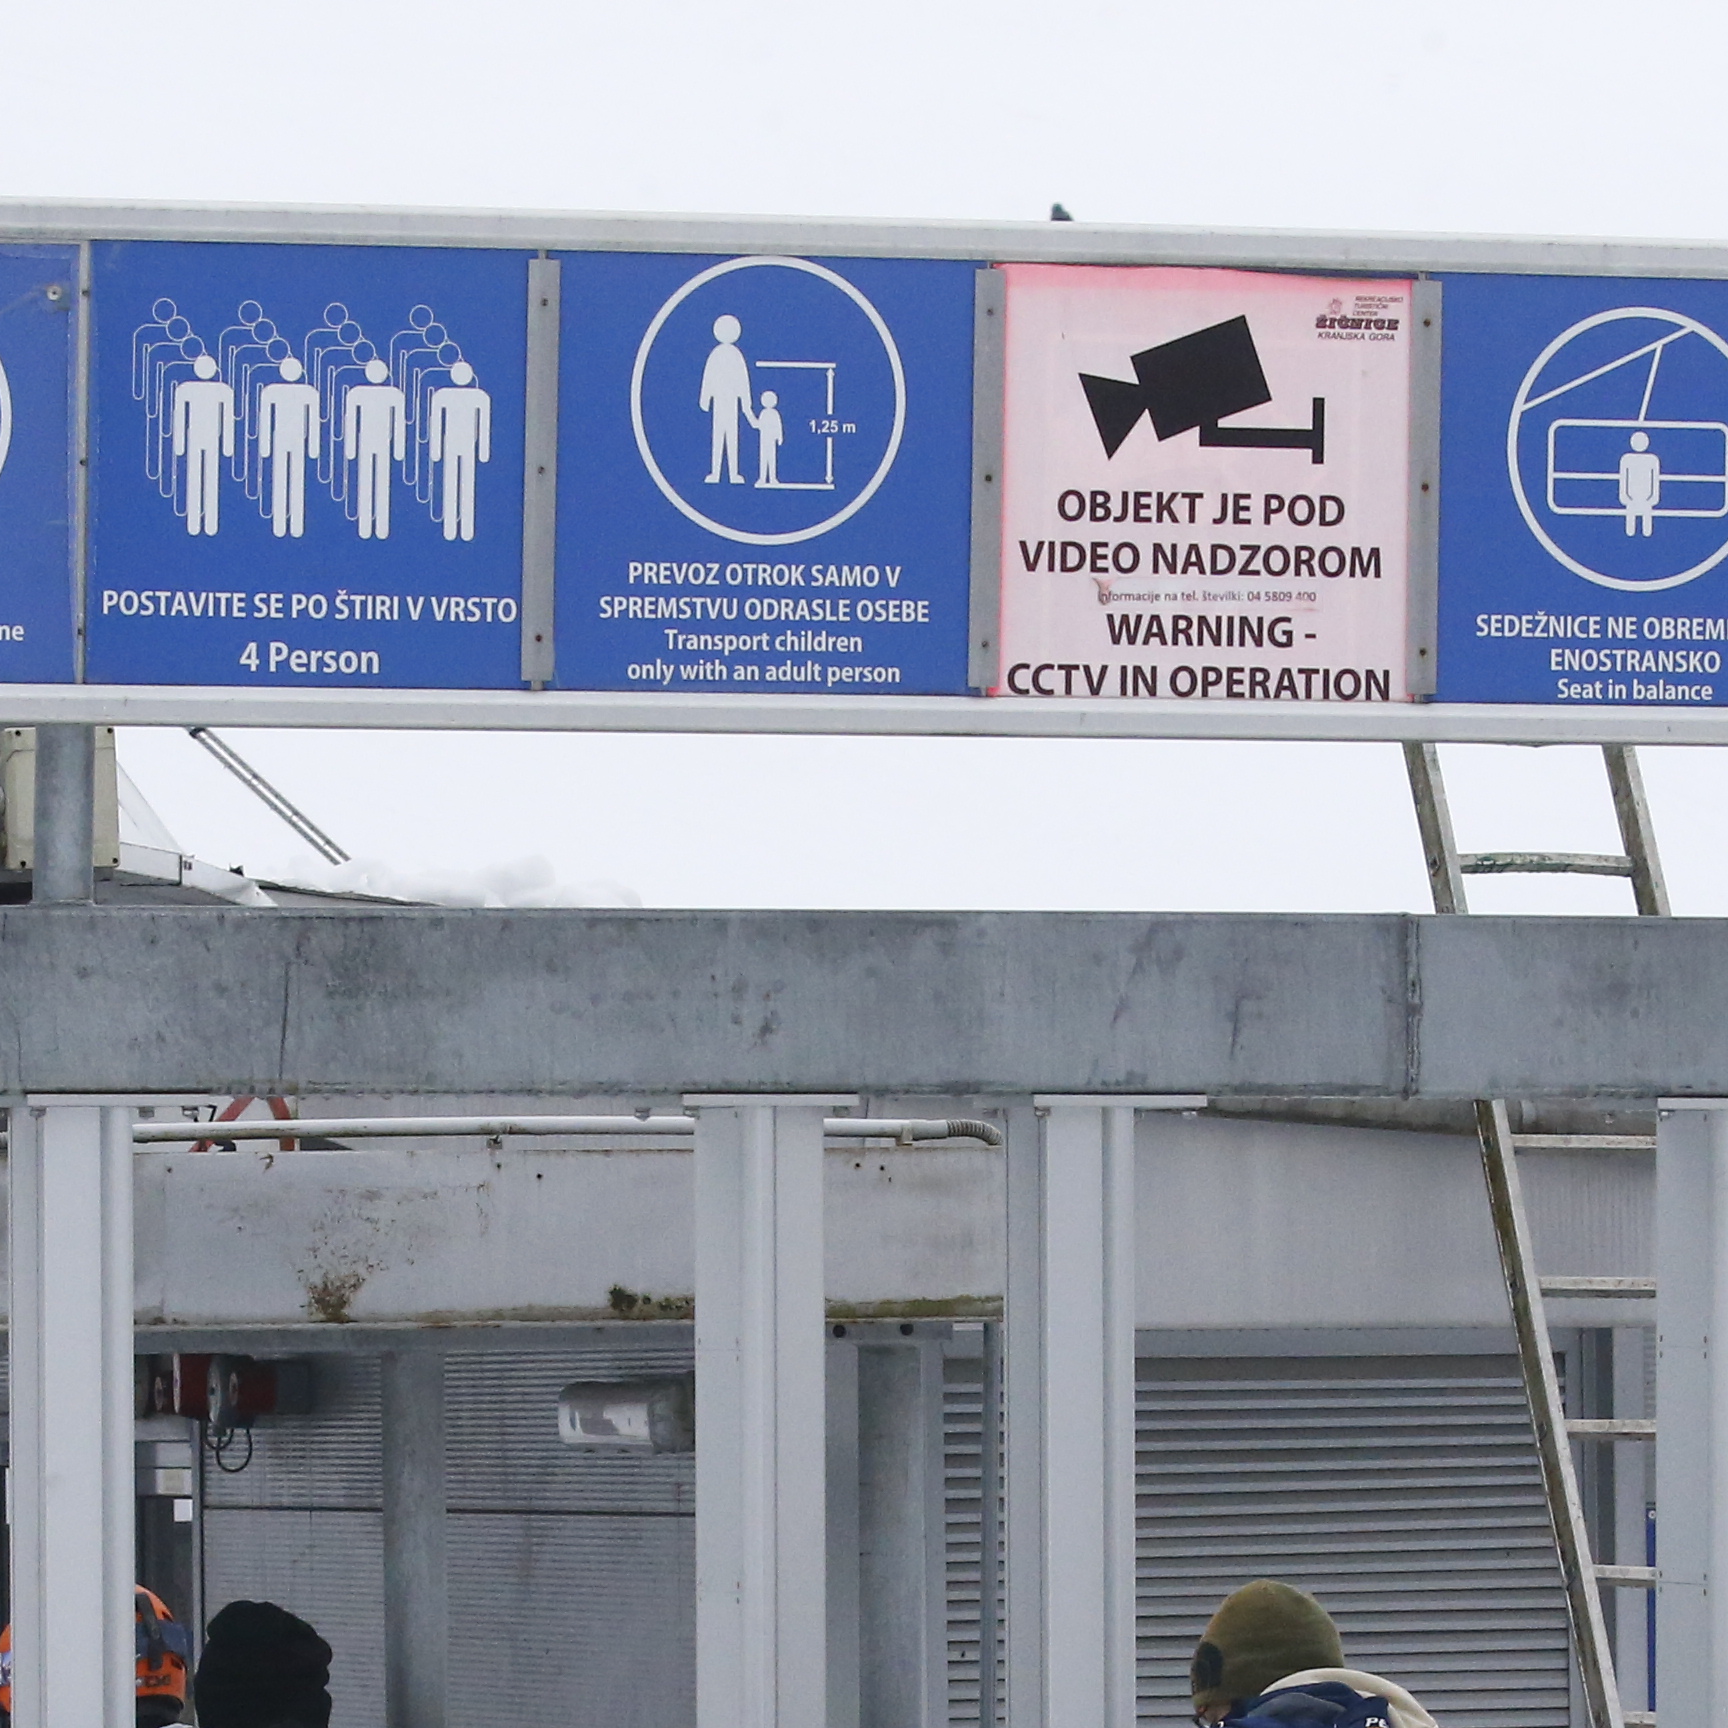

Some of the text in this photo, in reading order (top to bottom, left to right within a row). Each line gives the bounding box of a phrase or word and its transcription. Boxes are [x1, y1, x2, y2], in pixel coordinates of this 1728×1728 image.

[1316, 314, 1399, 330] ŽIČNICE
[1317, 332, 1395, 341] KRANJSKA GORA
[810, 420, 855, 434] 1,25 m
[1058, 490, 1345, 526] OBJEKT JE POD
[1019, 541, 1381, 578] VIDEO NADZOROM
[629, 562, 901, 587] PREVOZ OTROK SAMO V
[103, 590, 516, 622] POSTAVITE SE PO ŠTIRI V VRSTO
[600, 596, 929, 622] SPREMSTVU ODRASLE OSEBE
[1181, 590, 1198, 601] tel.
[1247, 591, 1261, 601] 04
[1265, 591, 1292, 602] 5809
[1107, 614, 1293, 648] WARNING
[1477, 611, 1601, 638] SEDEŽNICE
[1608, 617, 1637, 638] NE
[664, 629, 862, 655] Transport children
[240, 642, 379, 673] 4 Person
[1551, 649, 1720, 673] ENOSTRANSKO
[628, 659, 900, 687] only with an adult person
[1008, 663, 1389, 700] CCTV IN OPERATION
[1558, 679, 1712, 700] Seat in balance
